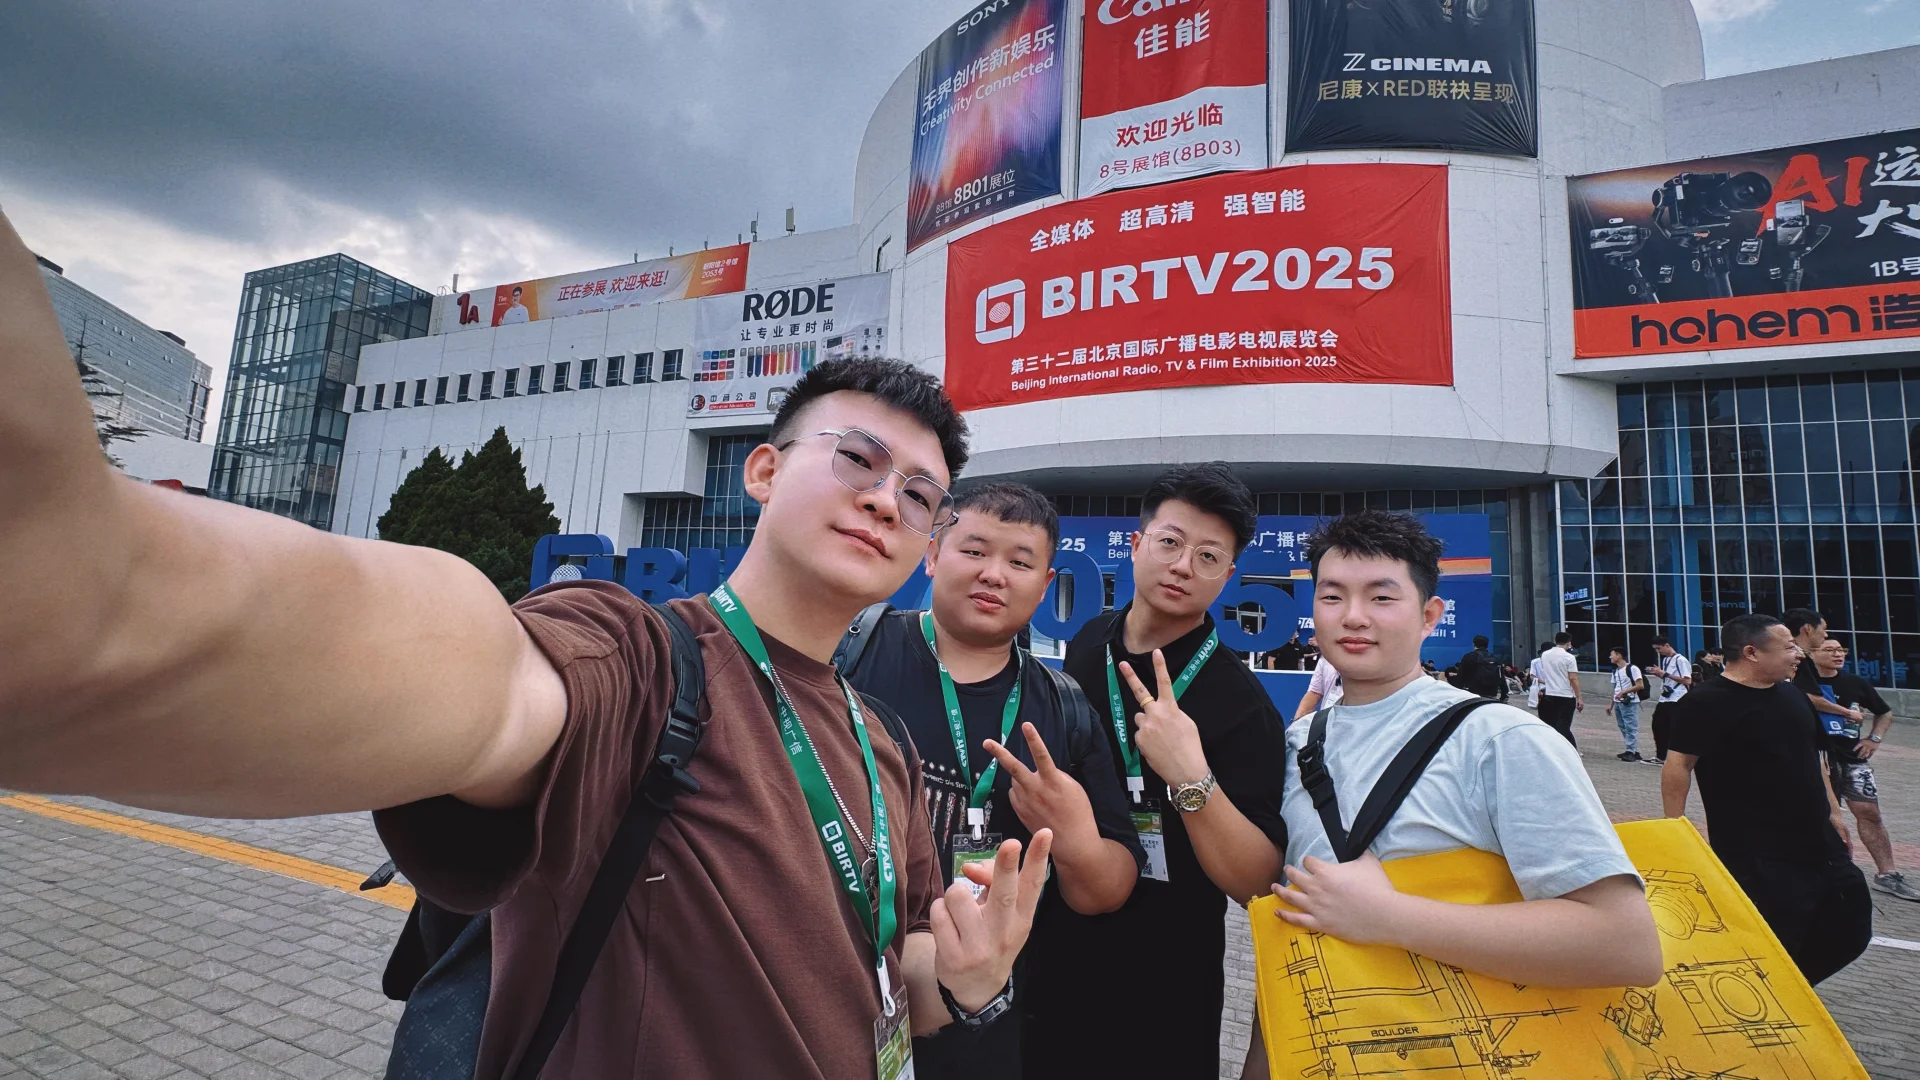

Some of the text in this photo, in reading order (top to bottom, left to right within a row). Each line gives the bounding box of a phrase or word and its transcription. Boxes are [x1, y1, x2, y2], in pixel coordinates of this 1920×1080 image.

[1133, 9, 1210, 59] 佳能
[922, 23, 1055, 117] 无界创作新娱乐
[1370, 57, 1493, 74] CINEMA
[920, 51, 1054, 136] Creativity Connected
[1115, 102, 1224, 149] 欢迎光临
[1029, 188, 1307, 253] 全媒体 超高清 强智能
[1855, 199, 1920, 241] 大
[556, 279, 608, 302] 正在参展
[742, 282, 836, 322] RØDE
[1042, 246, 1396, 319] BIRTV2025
[456, 292, 480, 326] 1A
[740, 318, 834, 342] 让专业更时尚
[1631, 303, 1861, 348] hohem
[1010, 328, 1339, 376] 第三十二届北京国际广播电影电视展览会
[1011, 355, 1338, 392] Beijing International Radio, TV & Film Exhibition 2025
[1056, 537, 1086, 552] 25
[831, 839, 861, 894] BIRTV
[1370, 1026, 1420, 1038] BOULDER
